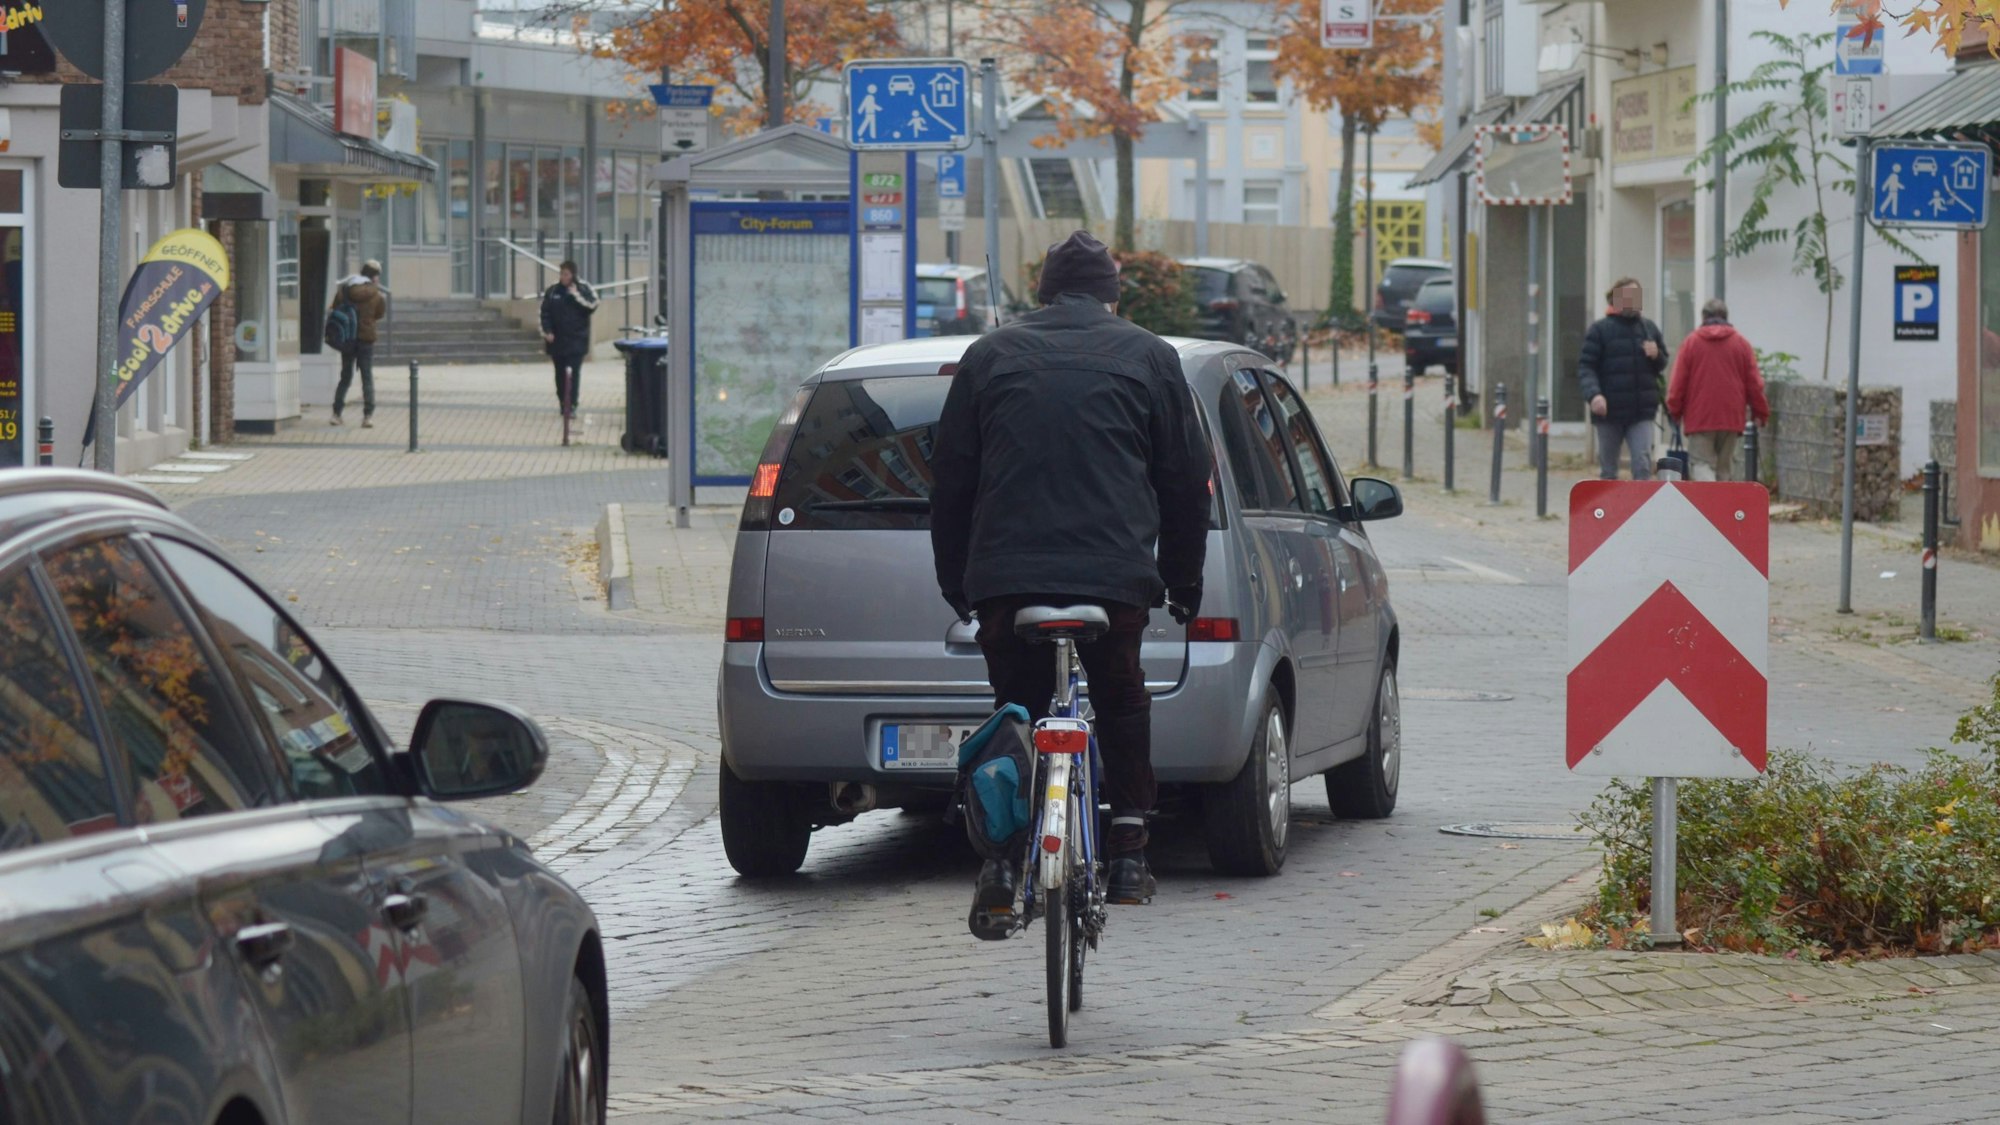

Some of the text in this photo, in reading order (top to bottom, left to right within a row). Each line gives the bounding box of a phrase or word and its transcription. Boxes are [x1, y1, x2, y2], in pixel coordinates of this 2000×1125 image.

[942, 156, 956, 175] P
[871, 174, 896, 187] 872
[870, 209, 893, 222] 860
[740, 217, 814, 233] City-Forum
[161, 245, 224, 274] GEÖFFNET
[126, 265, 184, 329] FAHRSCHULE
[1902, 284, 1934, 322] P
[775, 628, 826, 637] MERIVA
[887, 747, 894, 755] D
